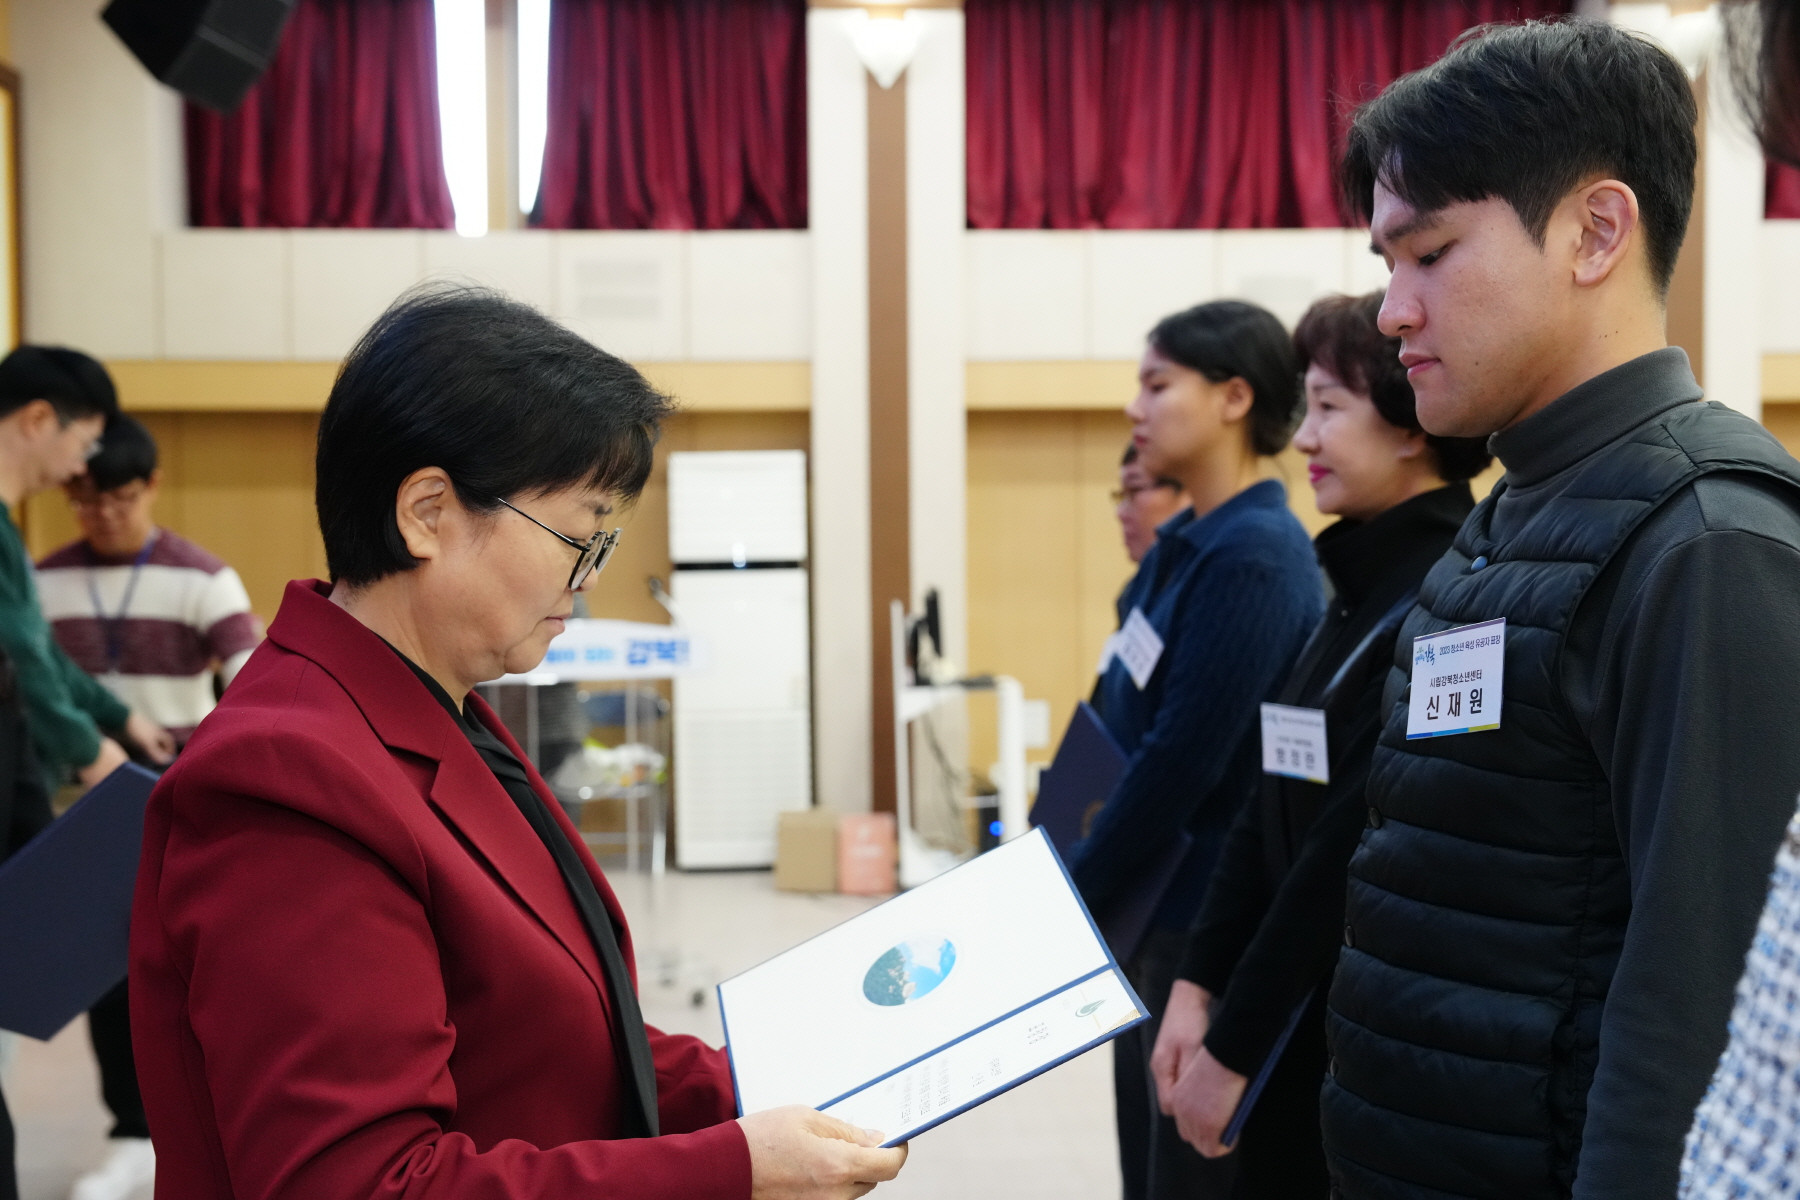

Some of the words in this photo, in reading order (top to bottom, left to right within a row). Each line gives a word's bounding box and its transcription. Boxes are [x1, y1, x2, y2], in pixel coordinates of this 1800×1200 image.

[1439, 645, 1450, 656] 2023
[1451, 642, 1465, 654] 청소년
[1475, 637, 1490, 648] 유공자
[1490, 634, 1501, 645] 표창
[1430, 669, 1483, 688] 시립강북청소년센터
